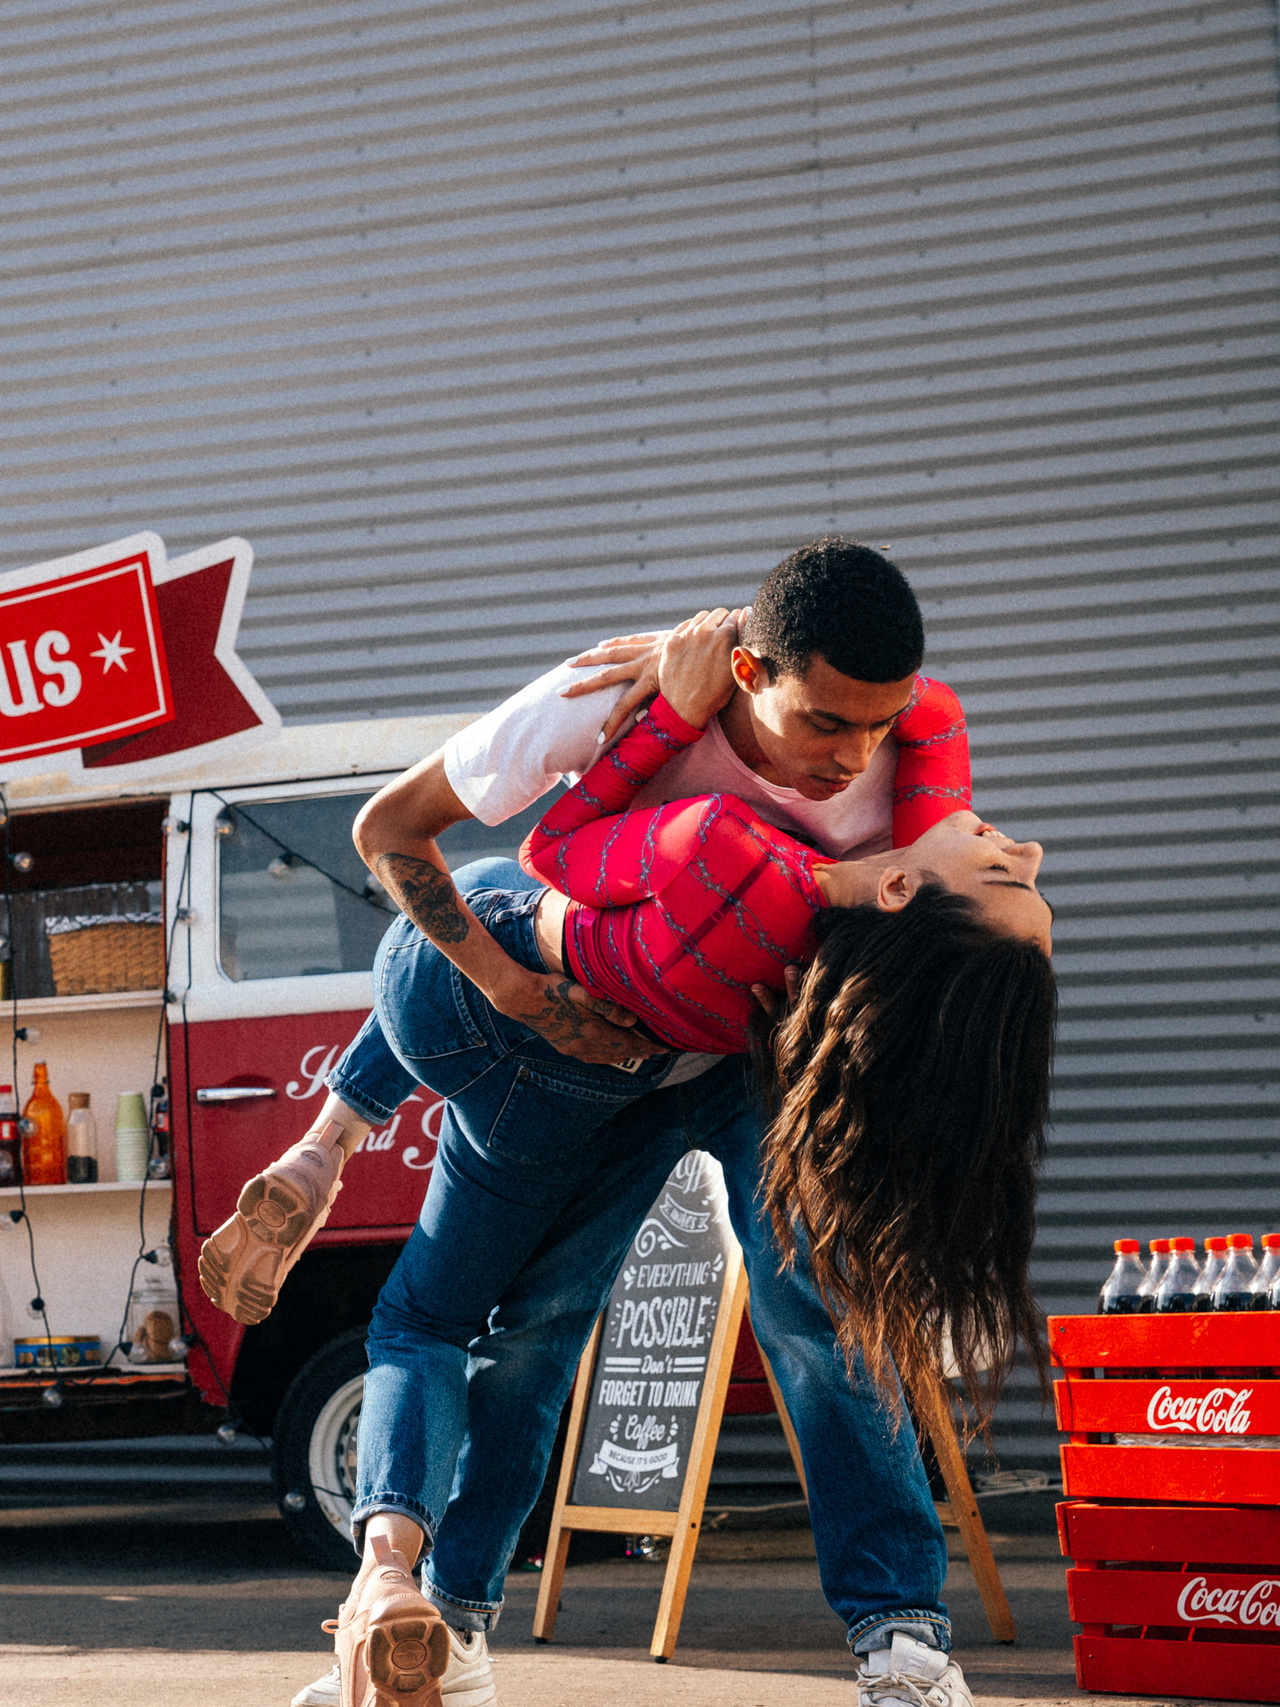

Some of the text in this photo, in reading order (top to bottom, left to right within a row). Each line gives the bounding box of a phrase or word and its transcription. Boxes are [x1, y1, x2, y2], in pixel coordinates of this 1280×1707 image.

[637, 1261, 711, 1288] EVERYTHING
[616, 1295, 713, 1349] POSSIBLE
[641, 1354, 673, 1374] Don't
[598, 1380, 700, 1407] FORGET TO DRINK
[1147, 1386, 1253, 1434] Coca-Cola
[625, 1414, 666, 1450] Coffee
